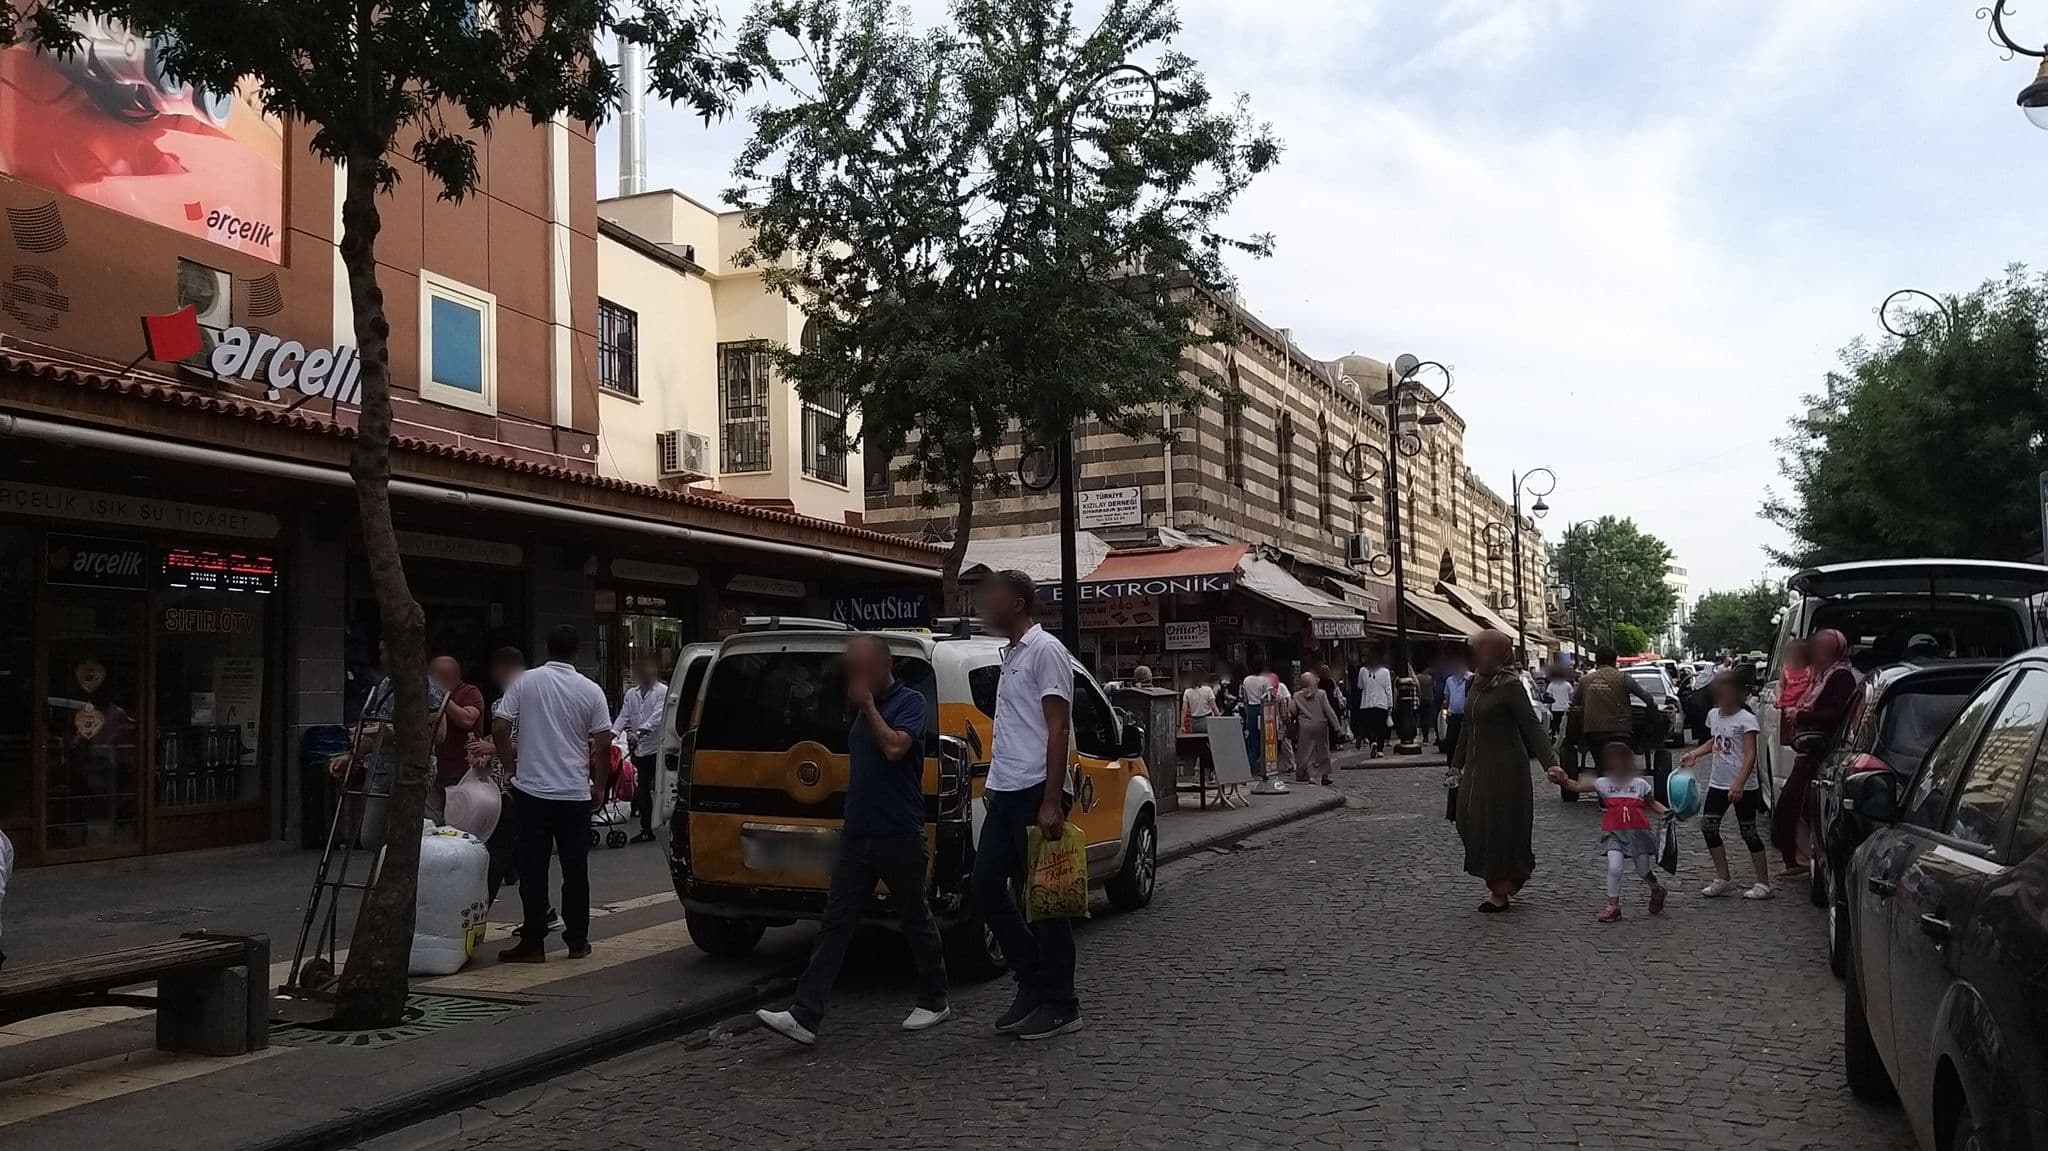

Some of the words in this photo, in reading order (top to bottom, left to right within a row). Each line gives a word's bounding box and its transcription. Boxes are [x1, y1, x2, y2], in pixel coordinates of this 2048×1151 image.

[207, 210, 274, 248] arçelik
[210, 326, 362, 405] arçeli
[73, 552, 142, 578] arçelik
[1053, 576, 1220, 601] EEKTRONİK
[851, 596, 921, 621] NextStar
